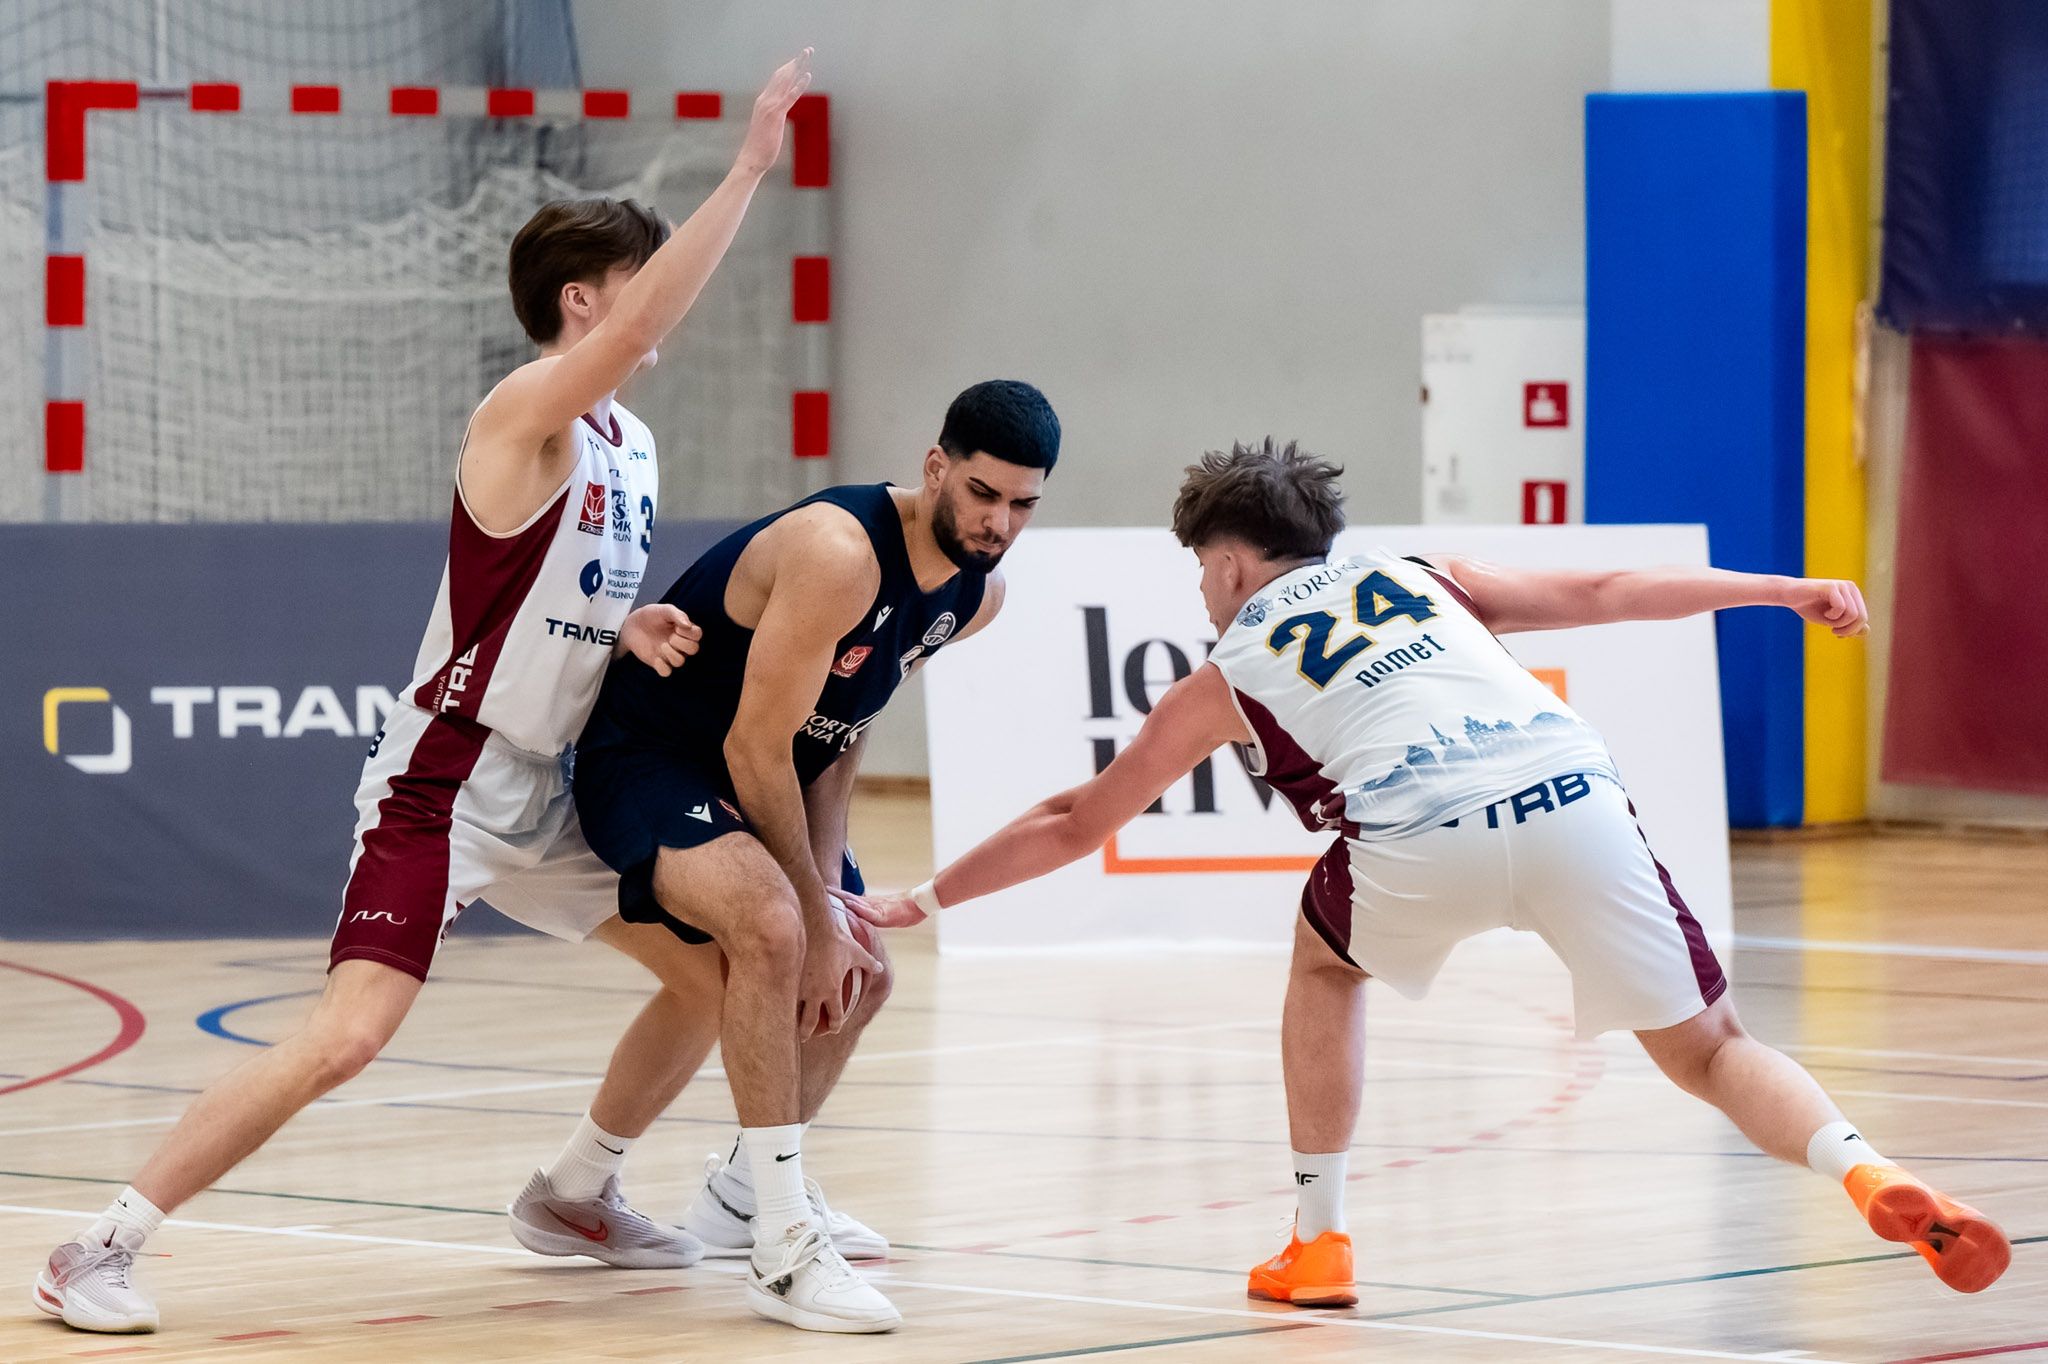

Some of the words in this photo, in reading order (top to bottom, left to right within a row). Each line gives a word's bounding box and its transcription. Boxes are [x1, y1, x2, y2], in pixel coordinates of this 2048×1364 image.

[1265, 569, 1443, 692] 24
[1355, 633, 1446, 688] nomet
[1485, 773, 1591, 829] TRB
